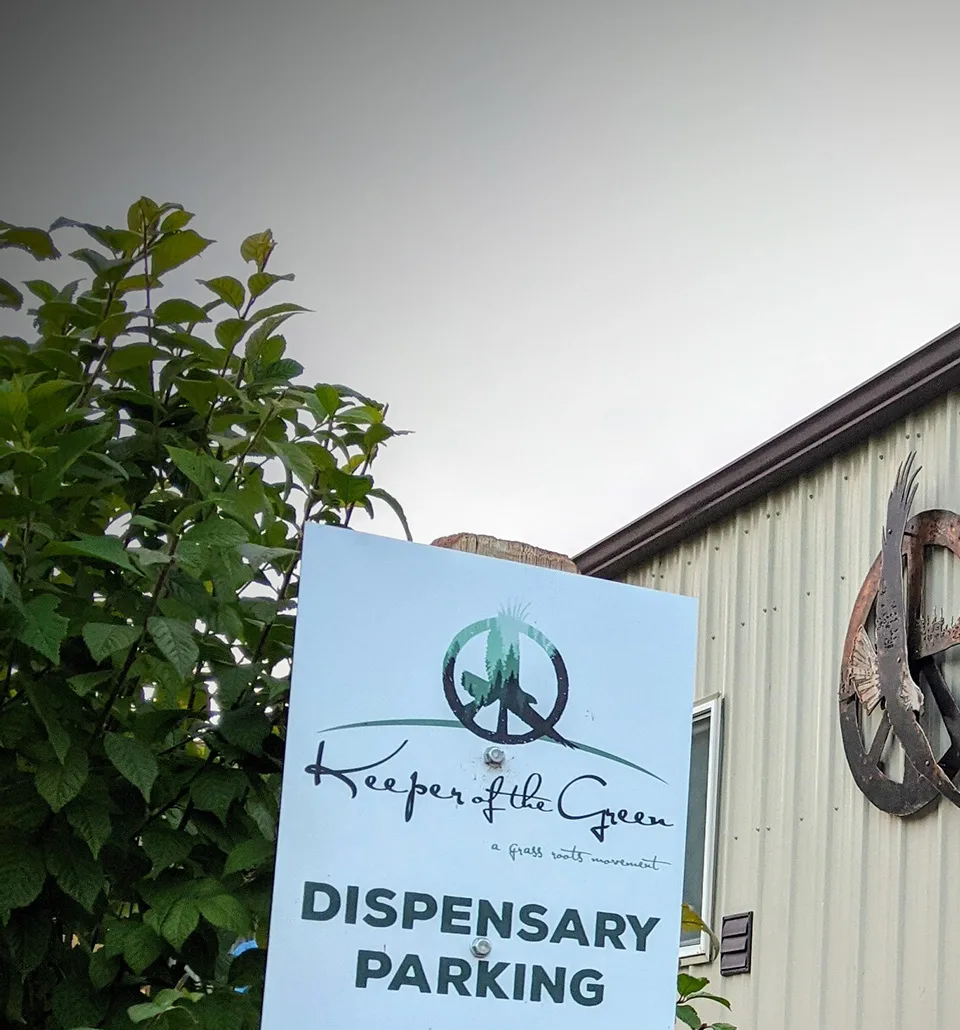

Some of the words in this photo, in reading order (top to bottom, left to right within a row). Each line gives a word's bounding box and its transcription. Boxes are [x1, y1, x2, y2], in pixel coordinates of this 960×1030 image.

[304, 739, 465, 823] Keeper
[471, 776, 506, 824] of
[498, 772, 554, 813] the
[557, 774, 674, 843] Green
[491, 843, 501, 851] a
[508, 843, 543, 861] grass
[551, 845, 592, 863] roots
[590, 855, 672, 871] movement
[301, 881, 661, 952] DISPENSARY
[355, 949, 605, 1007] PARKING
